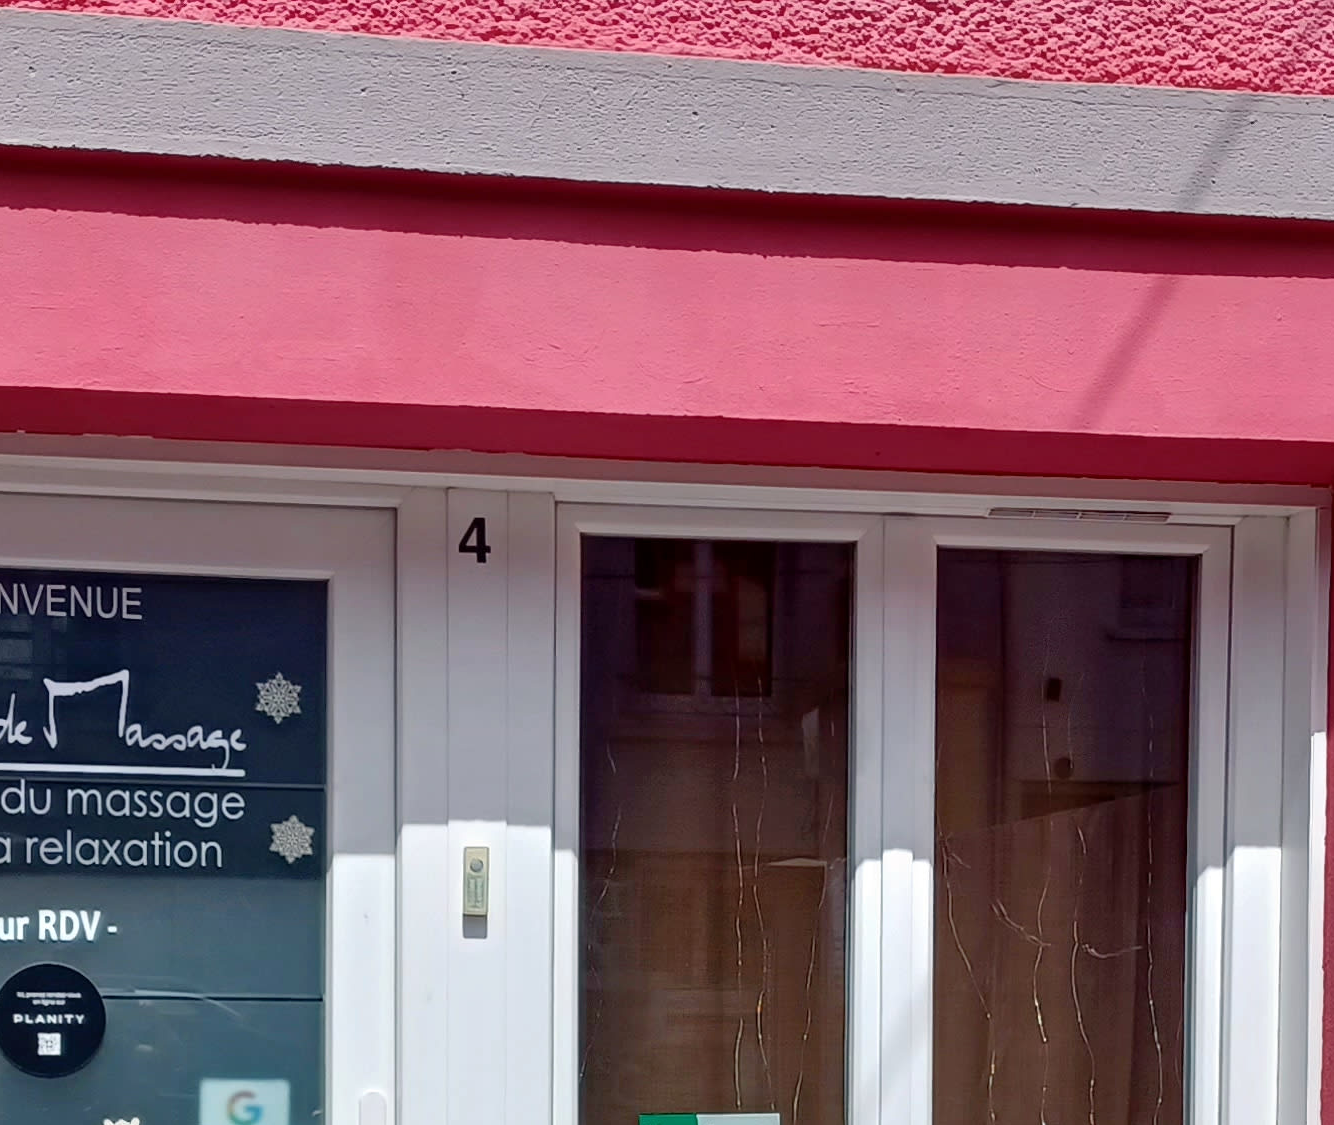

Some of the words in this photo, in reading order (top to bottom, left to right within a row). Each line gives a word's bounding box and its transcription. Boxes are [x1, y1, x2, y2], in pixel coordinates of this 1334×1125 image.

[458, 516, 491, 564] 4
[42, 668, 247, 770] Massage
[1, 778, 52, 815] du
[67, 786, 246, 828] massage
[26, 829, 223, 868] relaxation
[38, 909, 101, 942] RDV
[13, 1013, 85, 1024] PLANITY
